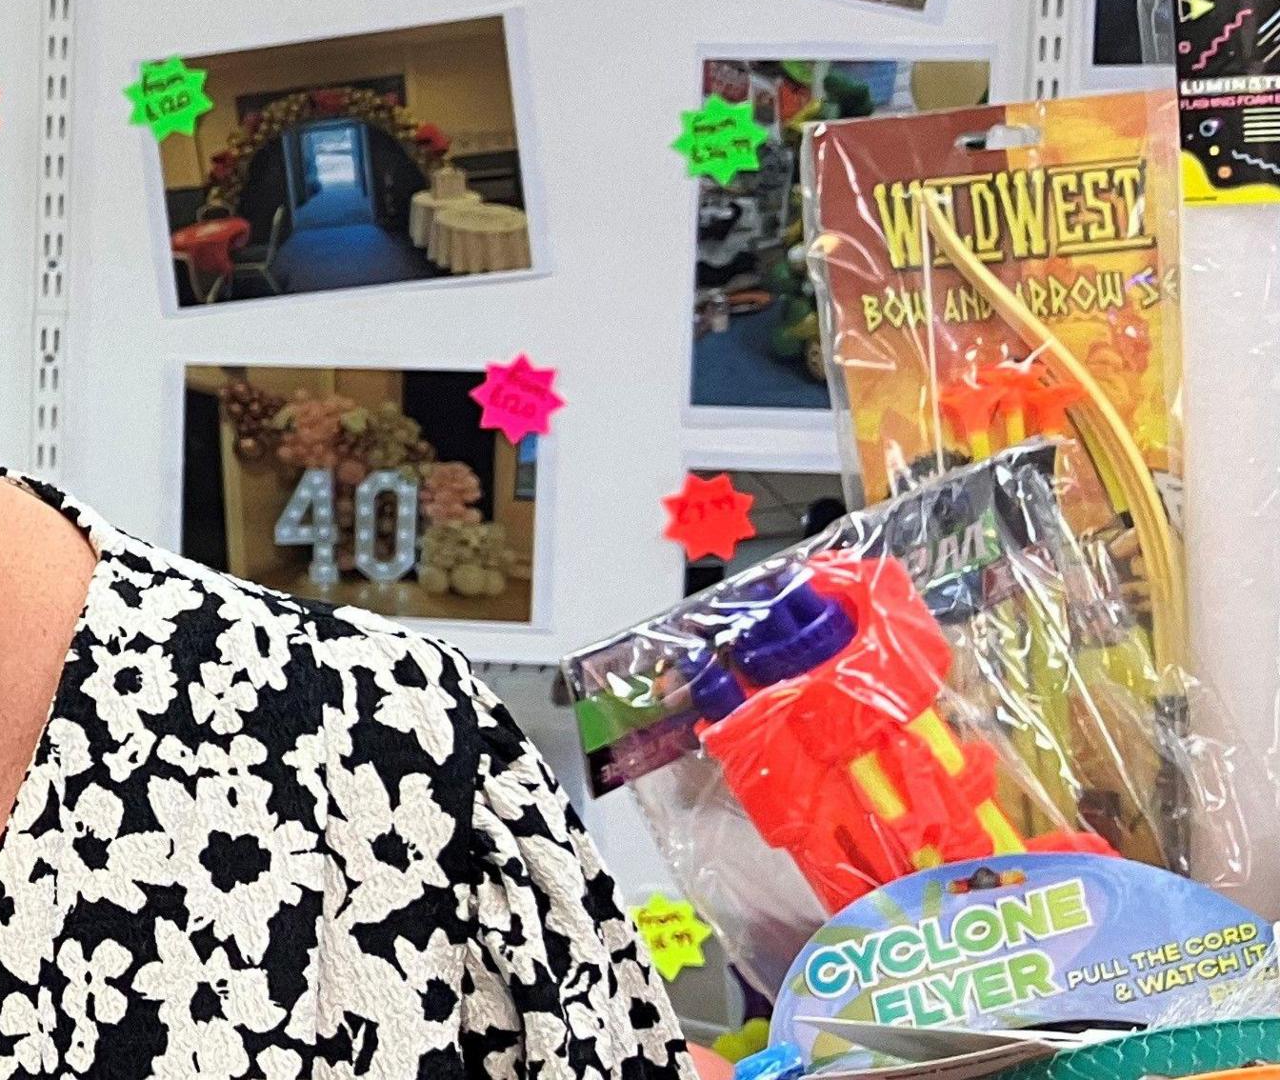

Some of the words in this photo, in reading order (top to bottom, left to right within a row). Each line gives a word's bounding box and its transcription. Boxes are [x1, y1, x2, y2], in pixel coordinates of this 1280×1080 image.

[274, 469, 417, 586] 40
[806, 877, 1093, 999] CYCLONE
[1066, 959, 1129, 991] PULL
[1130, 943, 1182, 970] THE
[1184, 922, 1258, 957] CORD
[871, 949, 1064, 1028] FLYER
[1113, 981, 1137, 1005] &
[1136, 952, 1240, 997] WATCH
